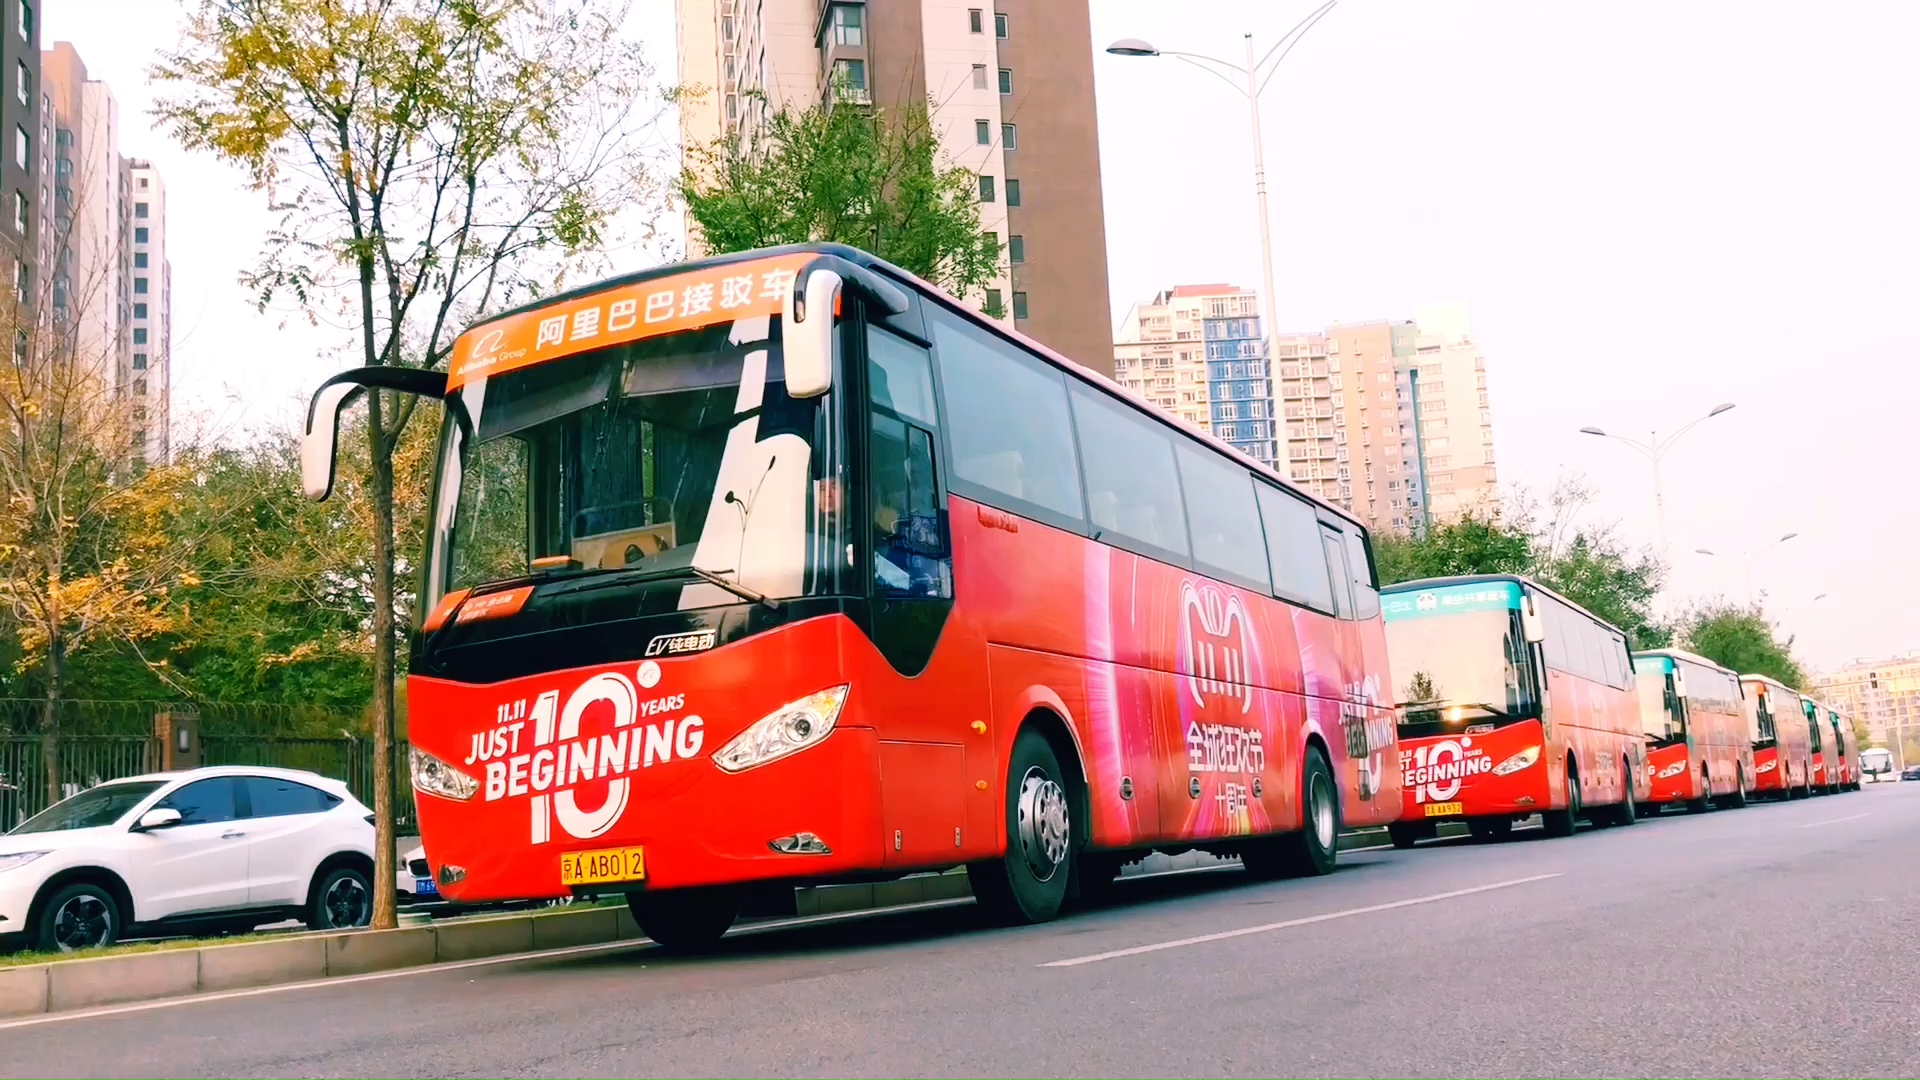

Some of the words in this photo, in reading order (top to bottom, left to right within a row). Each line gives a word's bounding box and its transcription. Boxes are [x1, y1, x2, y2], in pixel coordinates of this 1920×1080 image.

[536, 269, 794, 350] 阿里巴巴接驳车
[497, 699, 527, 724] 11.11
[640, 693, 686, 717] YEARS
[464, 722, 525, 765] JUST
[485, 715, 704, 801] BEGINNING
[1187, 721, 1265, 774] 全球狂欢节
